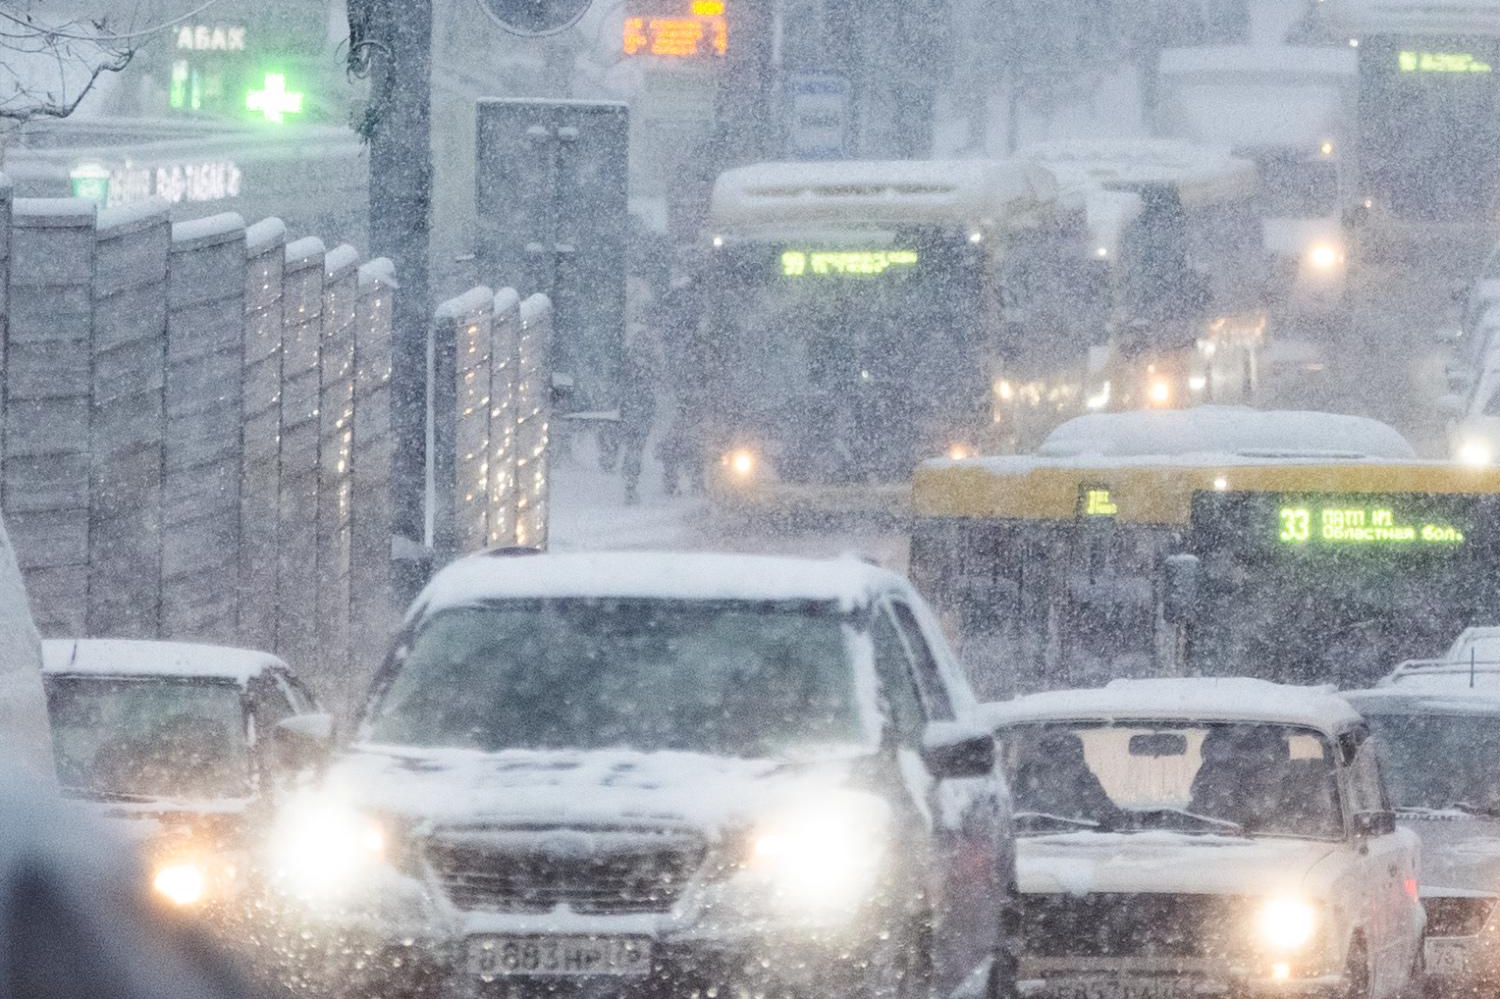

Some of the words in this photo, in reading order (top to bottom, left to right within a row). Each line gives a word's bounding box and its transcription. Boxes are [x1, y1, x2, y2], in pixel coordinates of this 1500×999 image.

[175, 24, 246, 50] АБАК
[1280, 508, 1310, 541] 33
[1322, 509, 1365, 526] ПАТП
